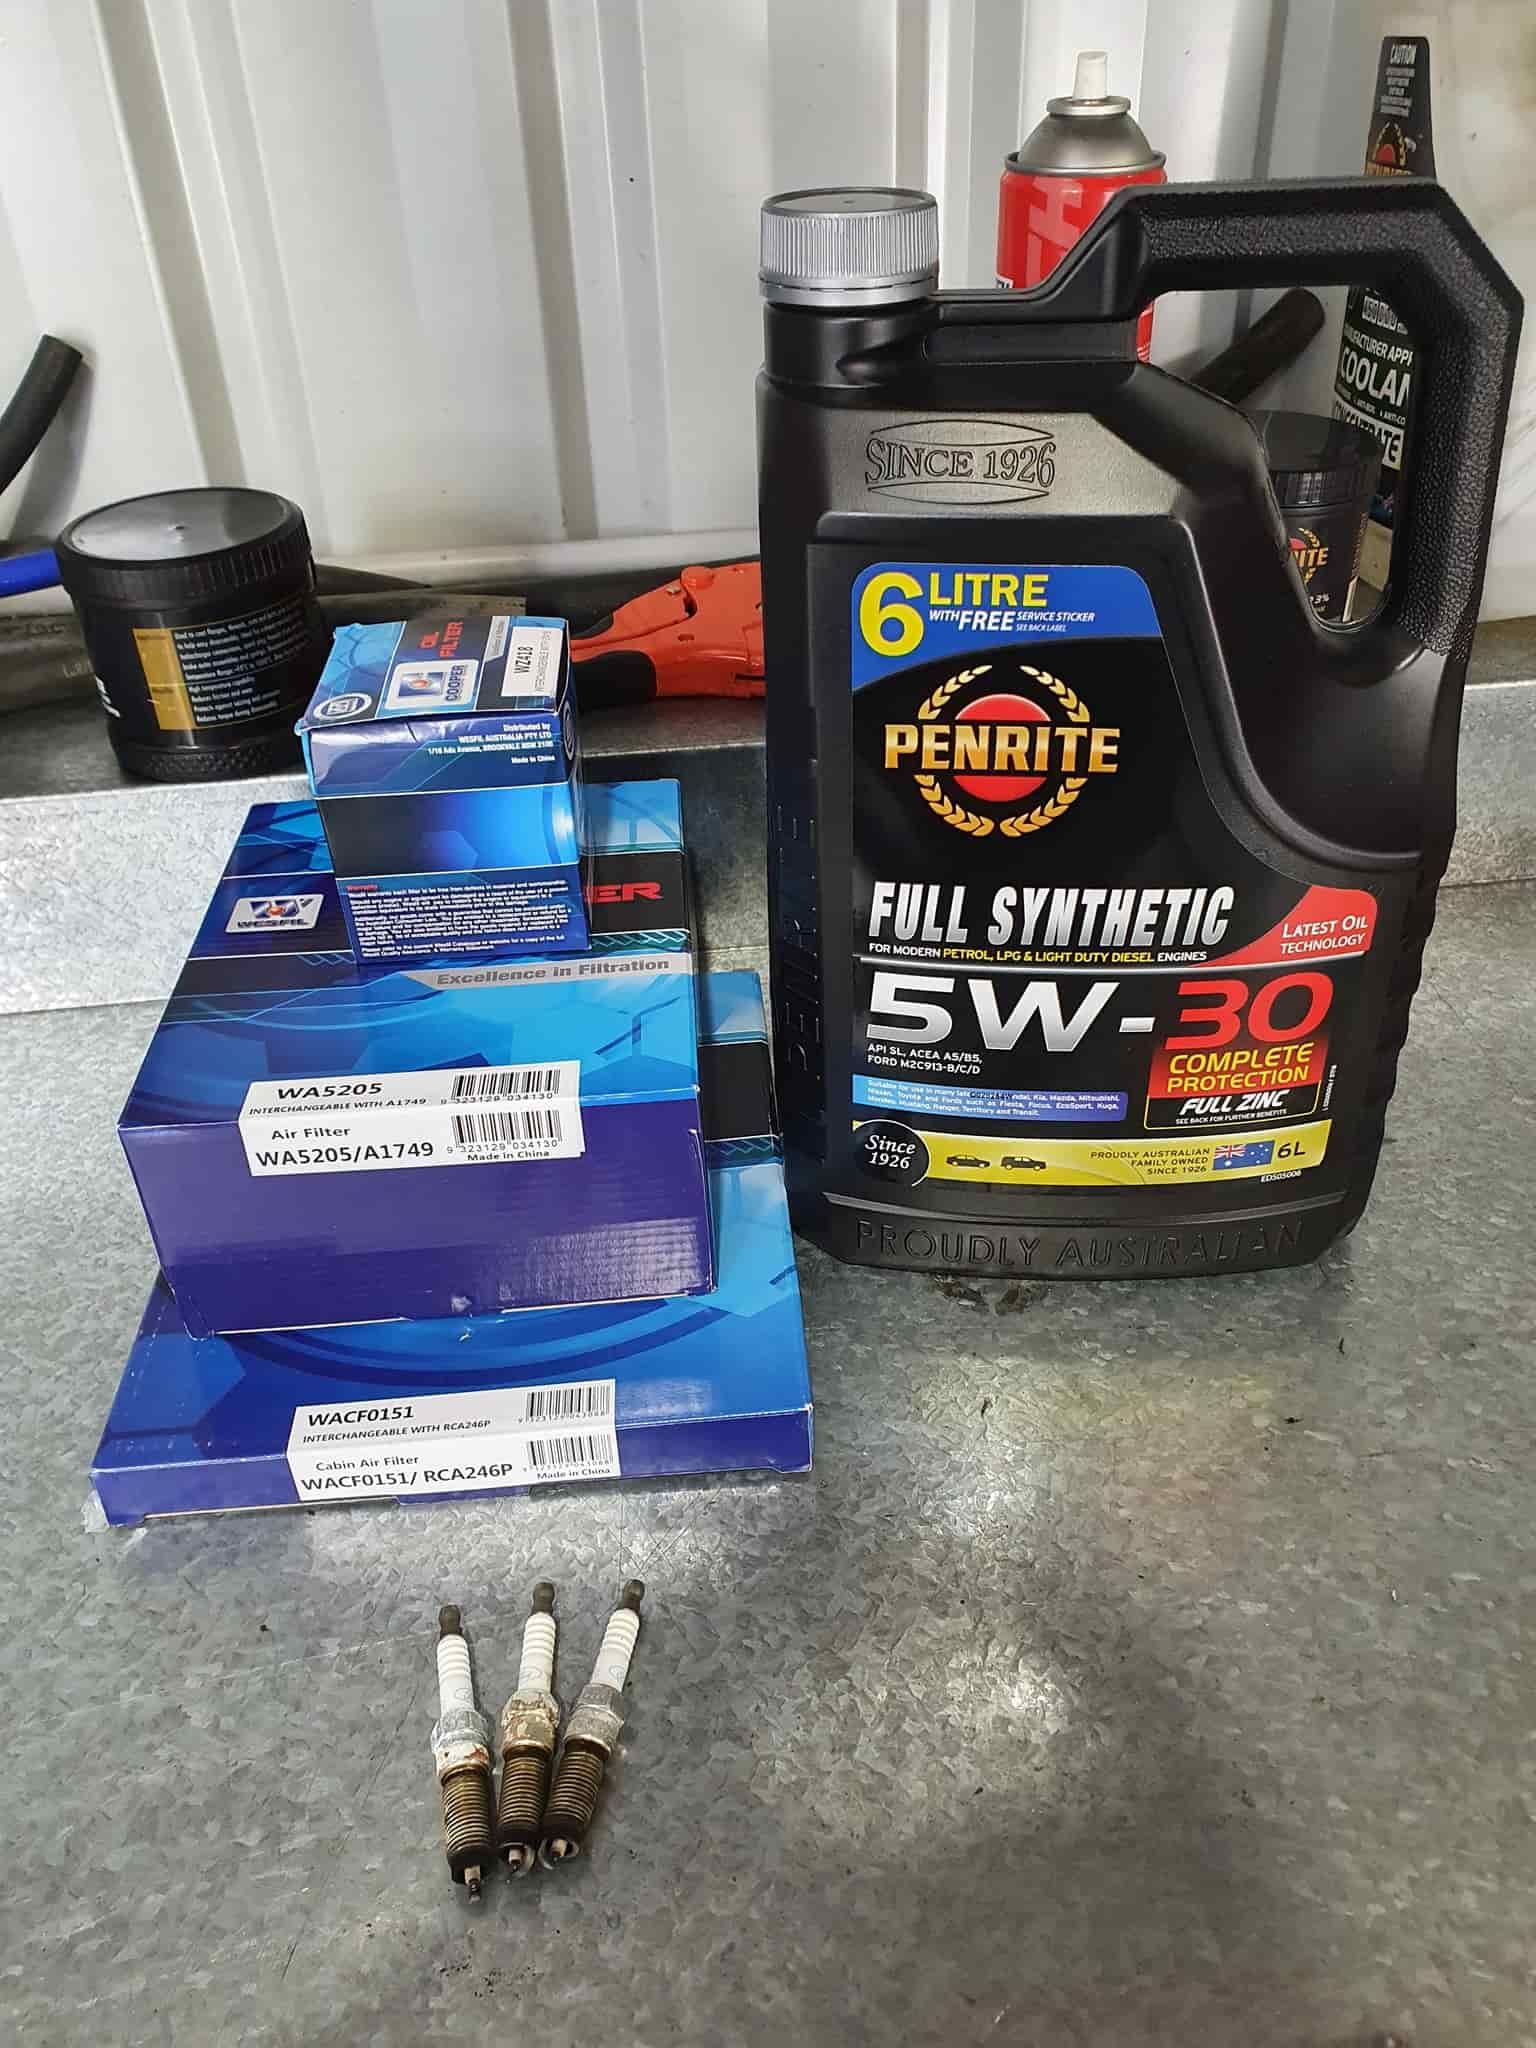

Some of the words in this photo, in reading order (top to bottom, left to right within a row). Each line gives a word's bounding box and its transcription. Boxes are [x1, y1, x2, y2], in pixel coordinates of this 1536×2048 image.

[865, 438, 974, 485] SINCE
[983, 441, 1056, 488] 1926
[859, 571, 924, 657] 6
[929, 572, 1049, 607] LITRE
[929, 609, 960, 622] WITH
[958, 610, 1016, 631] FREE
[1016, 611, 1056, 622] SERVICE
[1056, 611, 1095, 622] STICKER
[440, 621, 463, 658] FILTER
[514, 646, 533, 674] WZ418
[445, 665, 465, 702] COOPER
[539, 731, 552, 739] LTD
[885, 724, 1120, 773] PENRITE
[584, 882, 663, 904] ER
[868, 881, 971, 943] FULL
[987, 885, 1235, 947] SYNTHETIC
[1282, 919, 1338, 940] LATEST
[1341, 915, 1368, 932] OIL
[869, 943, 891, 954] FOR
[893, 945, 941, 958] MODERN
[943, 948, 993, 962] PETROL,
[997, 950, 1021, 961] LPG
[1023, 951, 1032, 962] &
[1035, 951, 1072, 963] LIGHT
[1074, 951, 1108, 963] DUTY
[1111, 951, 1155, 962] DIESEL
[1157, 951, 1207, 962] ENGINES
[1280, 933, 1365, 954] TECHNOLOGY
[437, 968, 546, 985] Excellence
[553, 966, 571, 977] in
[578, 960, 669, 975] Filtration
[865, 972, 1335, 1052] 5W-30
[868, 1043, 887, 1054] API
[889, 1045, 907, 1057] SL,
[910, 1047, 942, 1060] ACEA
[1169, 1042, 1315, 1074] COMPLETE
[867, 1055, 897, 1067] FORD
[900, 1058, 981, 1075] M2C913-B/C/D
[1167, 1065, 1310, 1093] PROTECTION
[276, 1082, 382, 1099] WA5205
[249, 1101, 350, 1115] INTERCHANGEABLE
[353, 1099, 383, 1109] WITH
[385, 1097, 427, 1107] A1749
[1179, 1095, 1233, 1115] FULL
[1236, 1090, 1290, 1111] ZINC
[1176, 1117, 1189, 1125] SEE
[1190, 1116, 1209, 1124] BACK
[1210, 1115, 1223, 1123] FOR
[1224, 1112, 1255, 1121] FURTHER
[1256, 1109, 1287, 1119] BENEFITS
[271, 1128, 299, 1140] Air
[303, 1126, 351, 1138] Filter
[256, 1142, 434, 1167] WA5205/A1749
[447, 1146, 454, 1154] 9
[460, 1142, 506, 1153] 323129
[512, 1140, 558, 1149] 034130
[865, 1134, 917, 1155] Since
[1090, 1149, 1140, 1160] PROUDLY
[1143, 1147, 1210, 1159] AUSTRALIAN
[1277, 1142, 1306, 1158] 6L
[467, 1152, 499, 1162] Made
[503, 1151, 515, 1160] in
[517, 1149, 550, 1158] China
[868, 1152, 910, 1170] 1926
[1131, 1157, 1169, 1167] FAMILY
[1171, 1156, 1209, 1166] OWNED
[1147, 1167, 1177, 1175] SINCE
[1182, 1165, 1207, 1174] 1926
[855, 1220, 1041, 1266] PROUDLY
[1056, 1223, 1304, 1266] AUSTRALIAN
[308, 1406, 414, 1426] WACF0151
[303, 1426, 407, 1443] INTERCHANGEABLE
[410, 1424, 440, 1434] WITH
[443, 1419, 491, 1431] RCA246P
[316, 1460, 355, 1471] Cabin
[360, 1458, 379, 1468] Air
[384, 1455, 420, 1466] Filter
[537, 1471, 565, 1479] Made
[581, 1468, 611, 1476] China
[301, 1471, 417, 1491] WACF0151/
[424, 1463, 513, 1483] RCA246P
